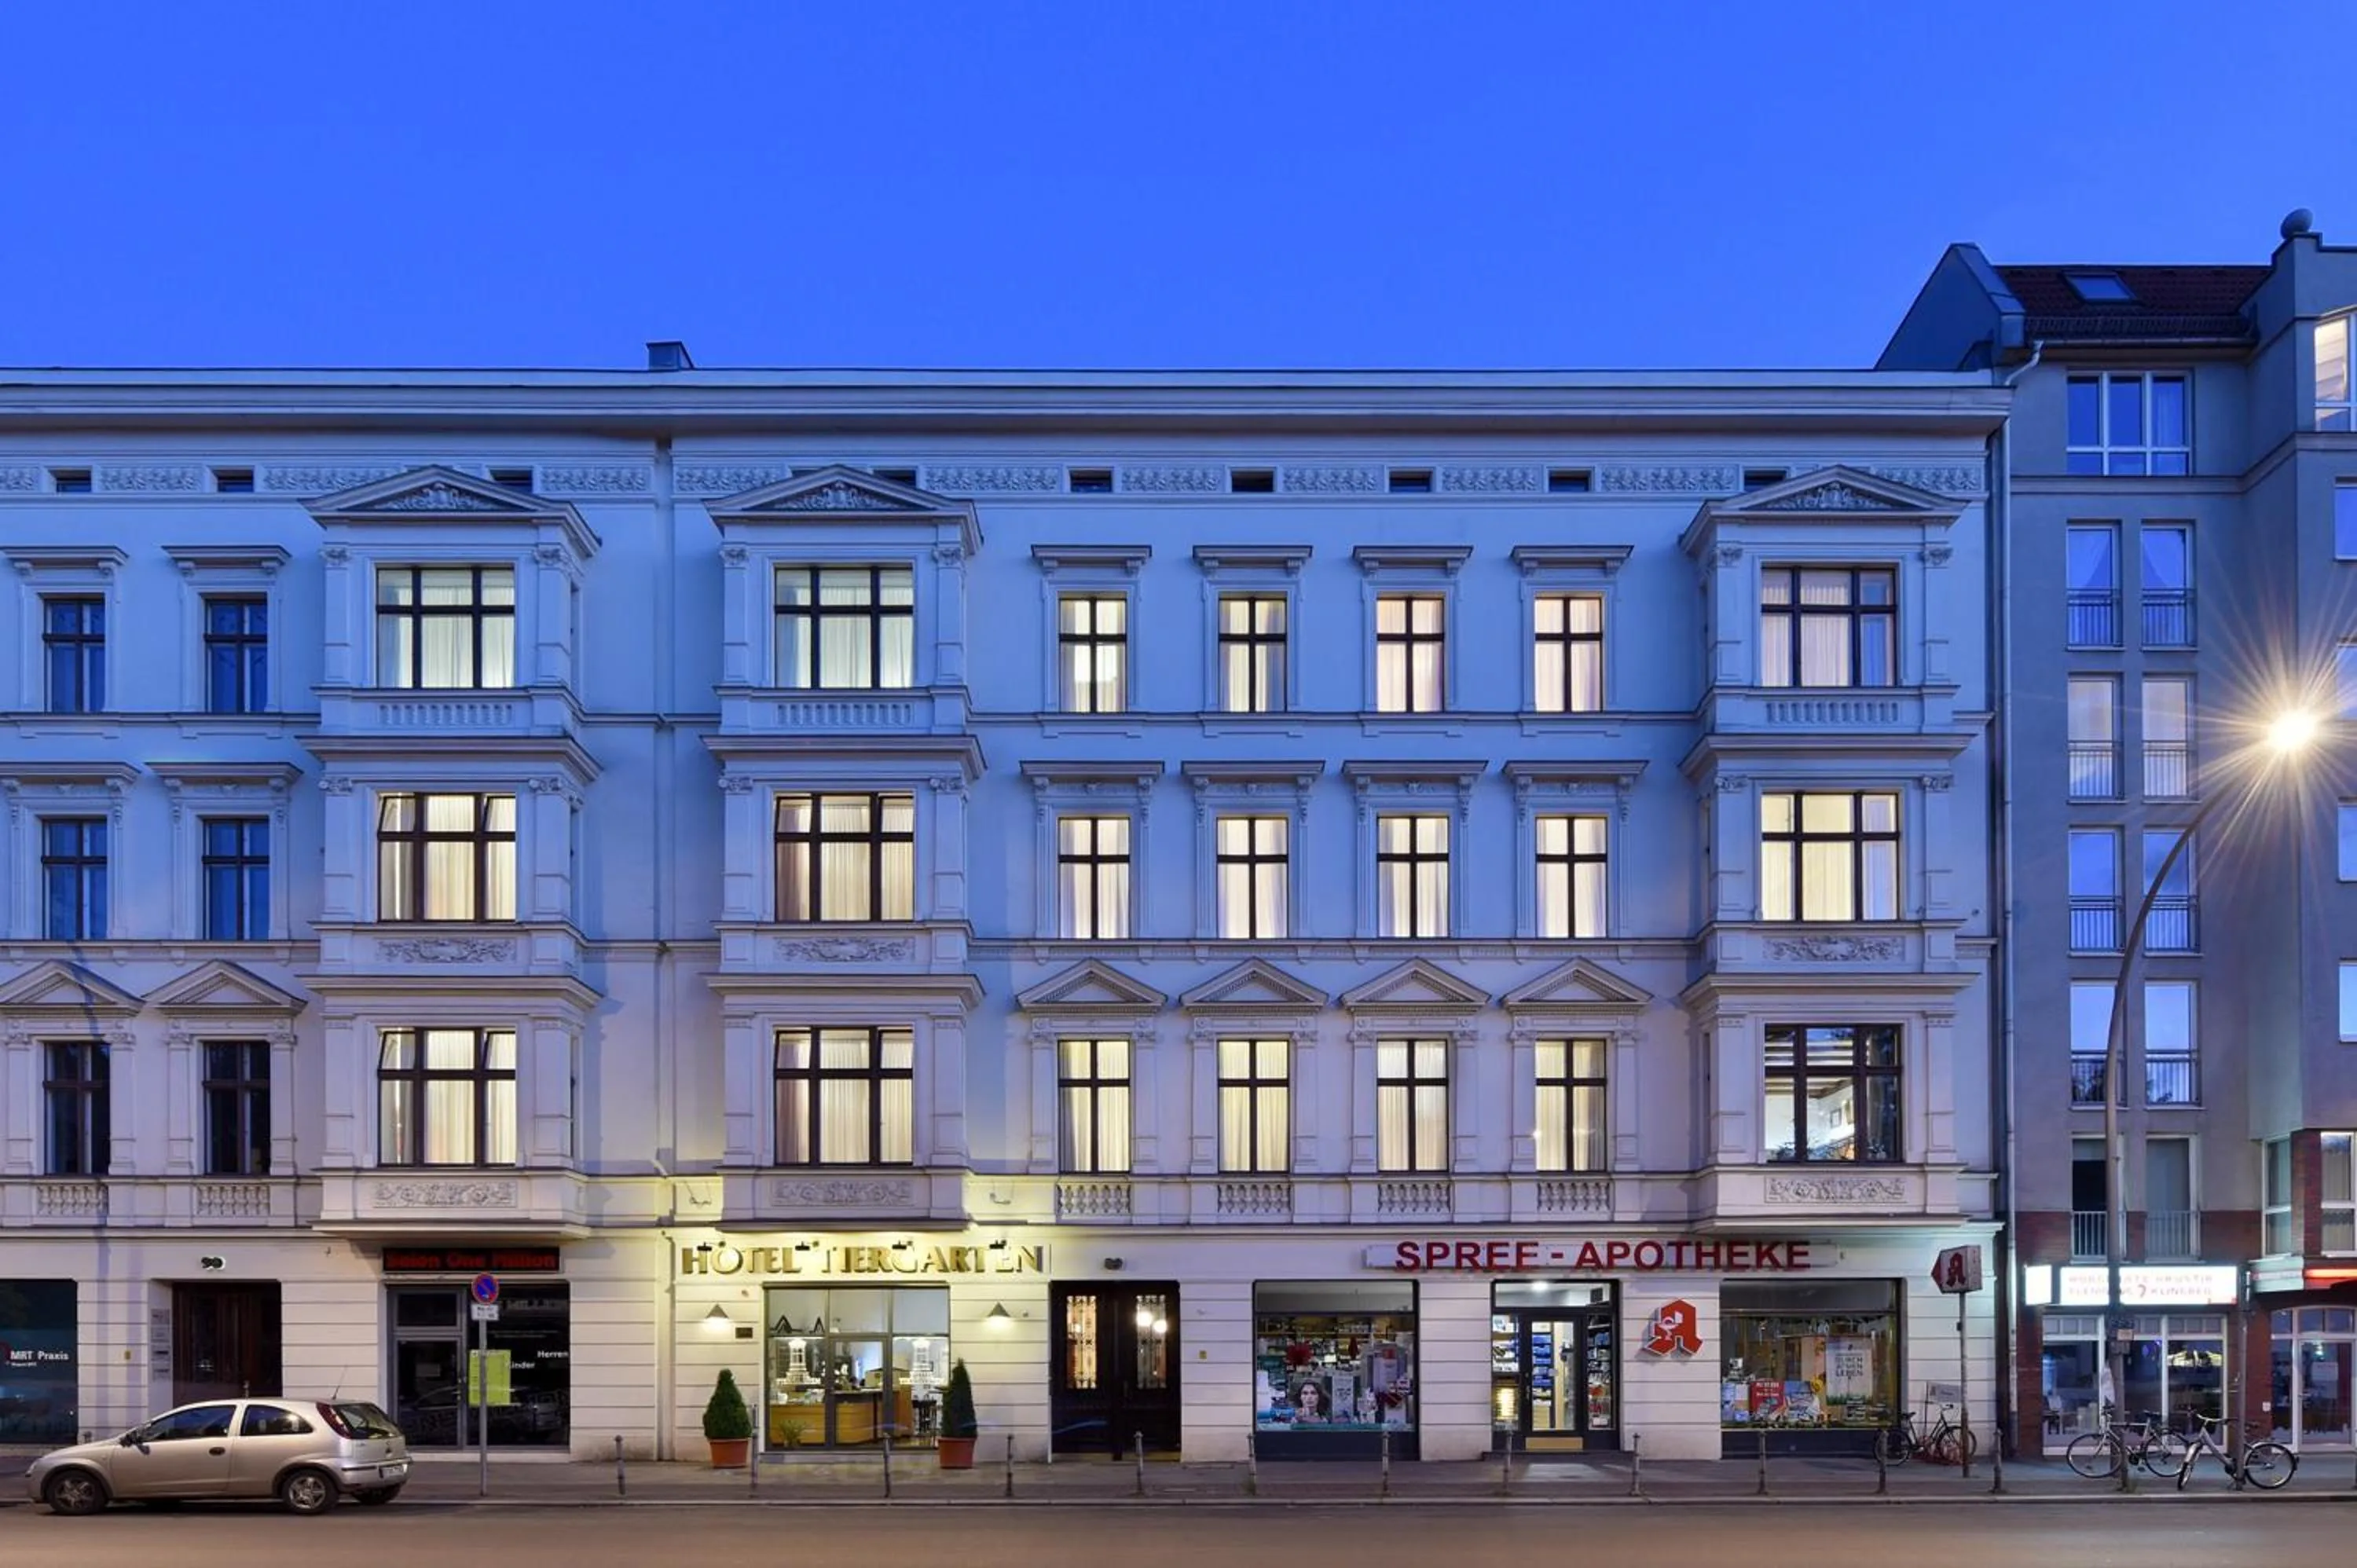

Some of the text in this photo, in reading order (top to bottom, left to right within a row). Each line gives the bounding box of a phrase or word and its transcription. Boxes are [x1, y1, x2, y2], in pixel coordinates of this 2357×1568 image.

[681, 1246, 1043, 1275] HOTEL TIERGARTEN
[1395, 1241, 1539, 1270] SPREE
[1574, 1240, 1811, 1270] APOTHEKE
[10, 1350, 69, 1361] MRT Praxis
